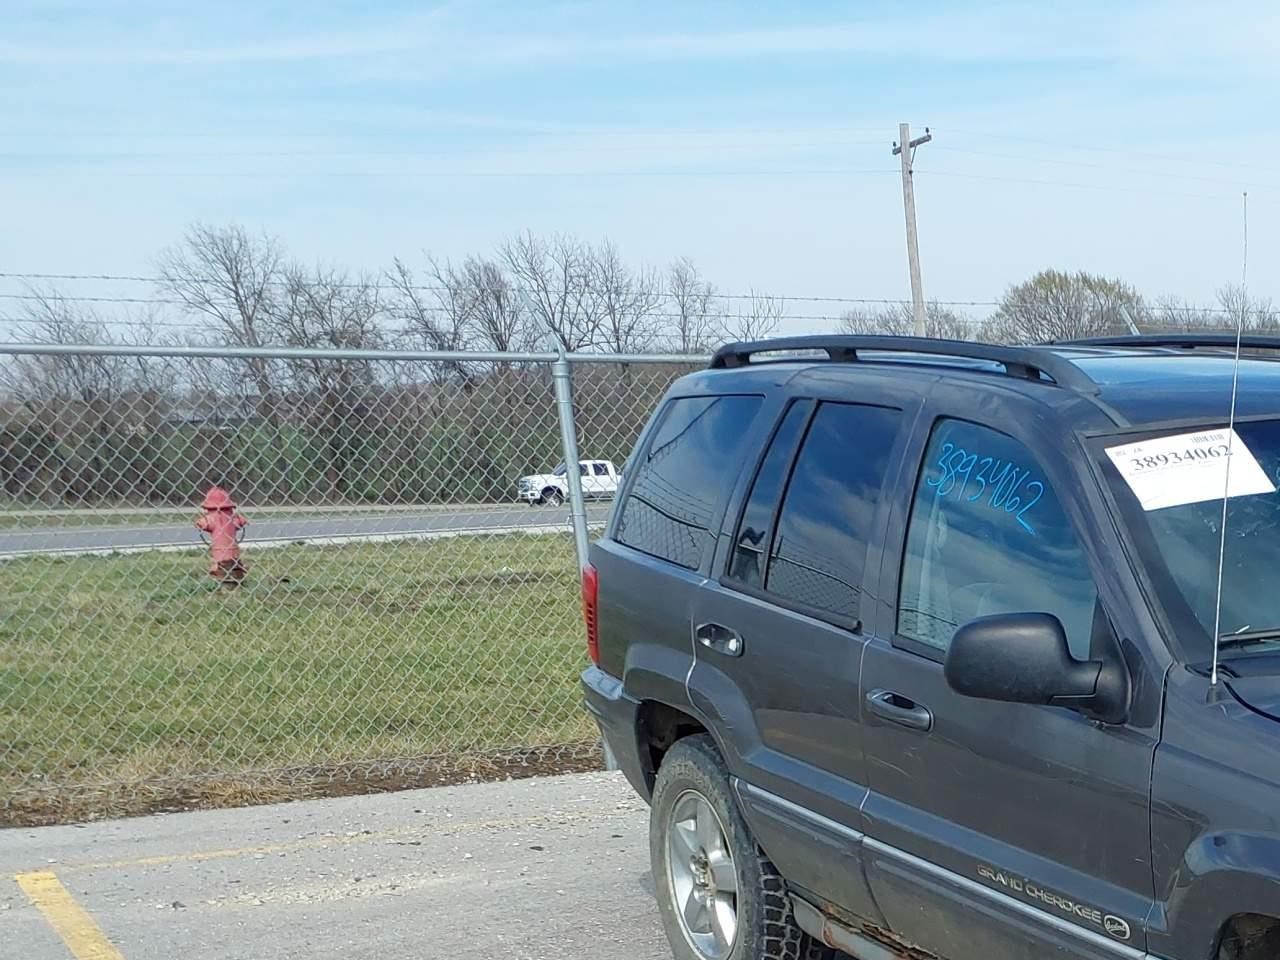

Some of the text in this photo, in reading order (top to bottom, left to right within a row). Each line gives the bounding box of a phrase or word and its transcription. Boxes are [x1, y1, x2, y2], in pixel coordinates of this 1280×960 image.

[1130, 444, 1233, 471] 38934062
[928, 443, 1044, 536] 38934062
[977, 864, 1023, 892] GRAND
[1026, 885, 1102, 923] CHEROKEE
